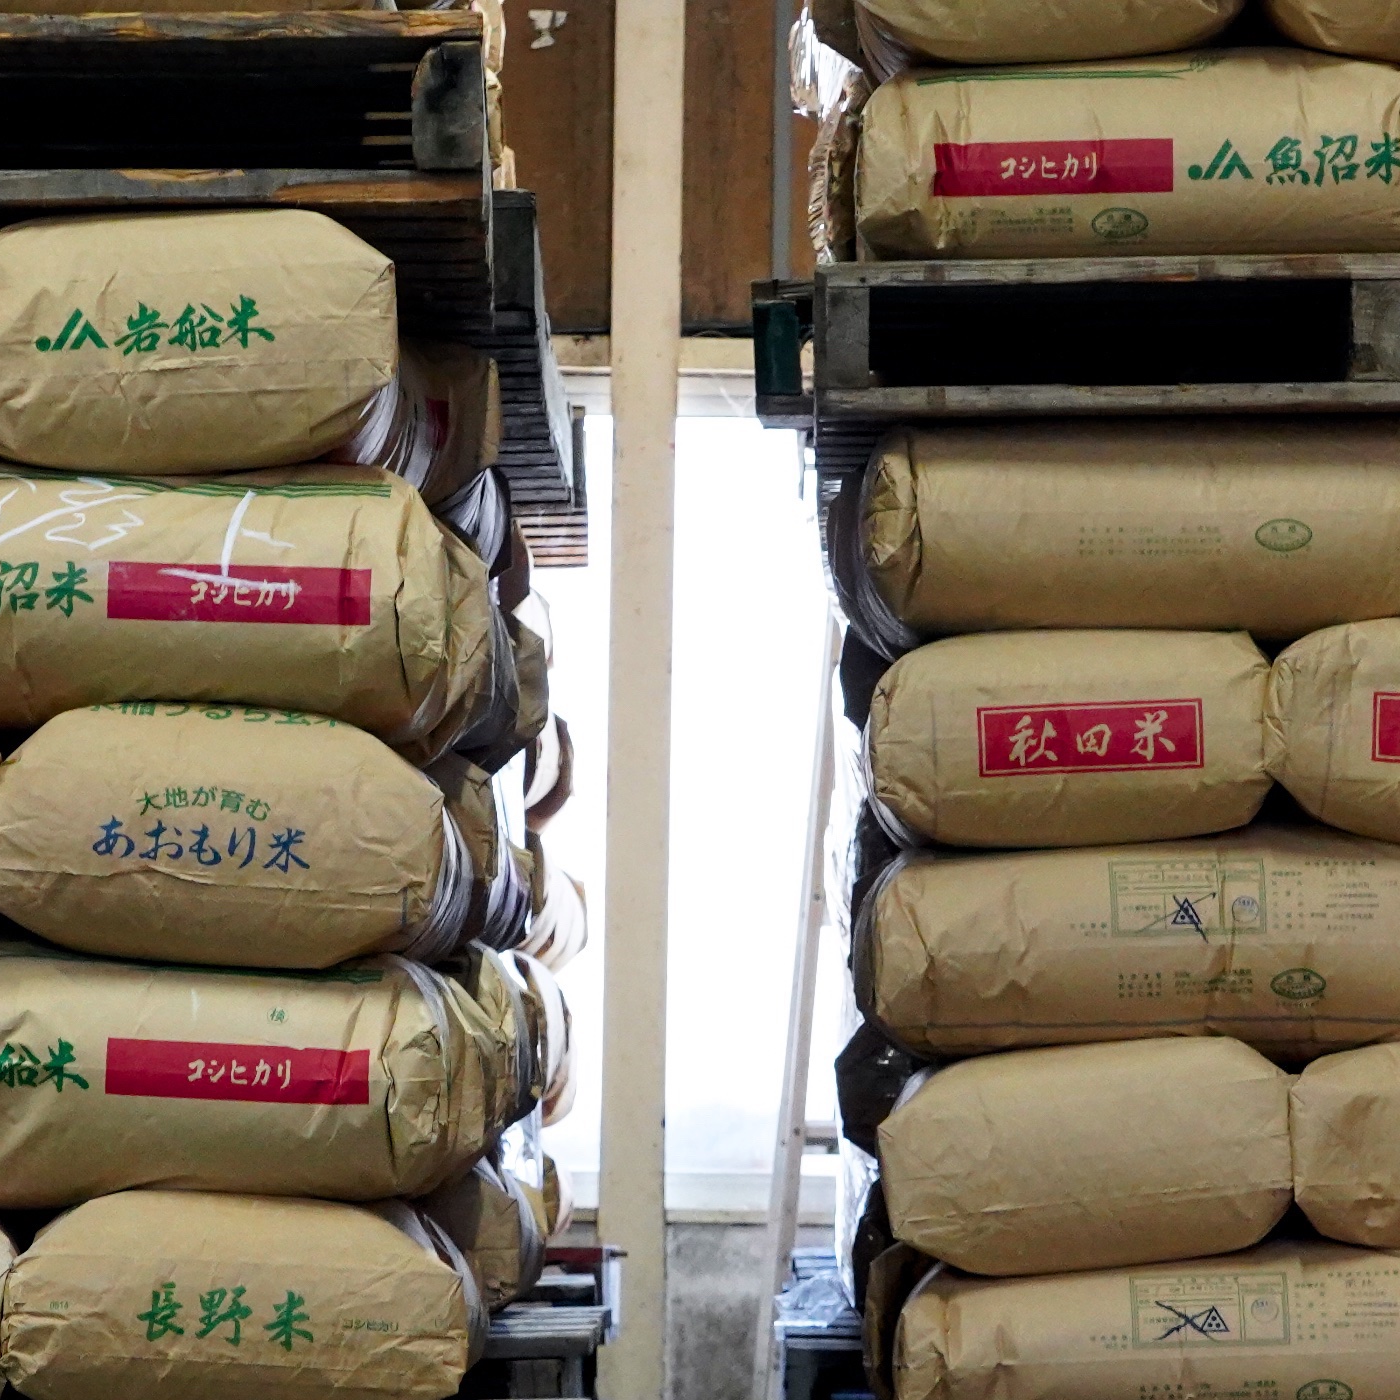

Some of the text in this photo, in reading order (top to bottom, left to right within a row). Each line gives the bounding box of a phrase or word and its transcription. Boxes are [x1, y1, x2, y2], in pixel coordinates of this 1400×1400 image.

[999, 153, 1099, 182] コシヒカリ
[116, 296, 275, 355] 岩船米
[190, 578, 302, 612] コシヒカリ
[1008, 711, 1176, 767] 秋田米
[137, 786, 271, 821] 大地が育む
[92, 816, 310, 871] あおもり米
[188, 1058, 292, 1090] コシヒカリ
[137, 1282, 315, 1352] 長野米
